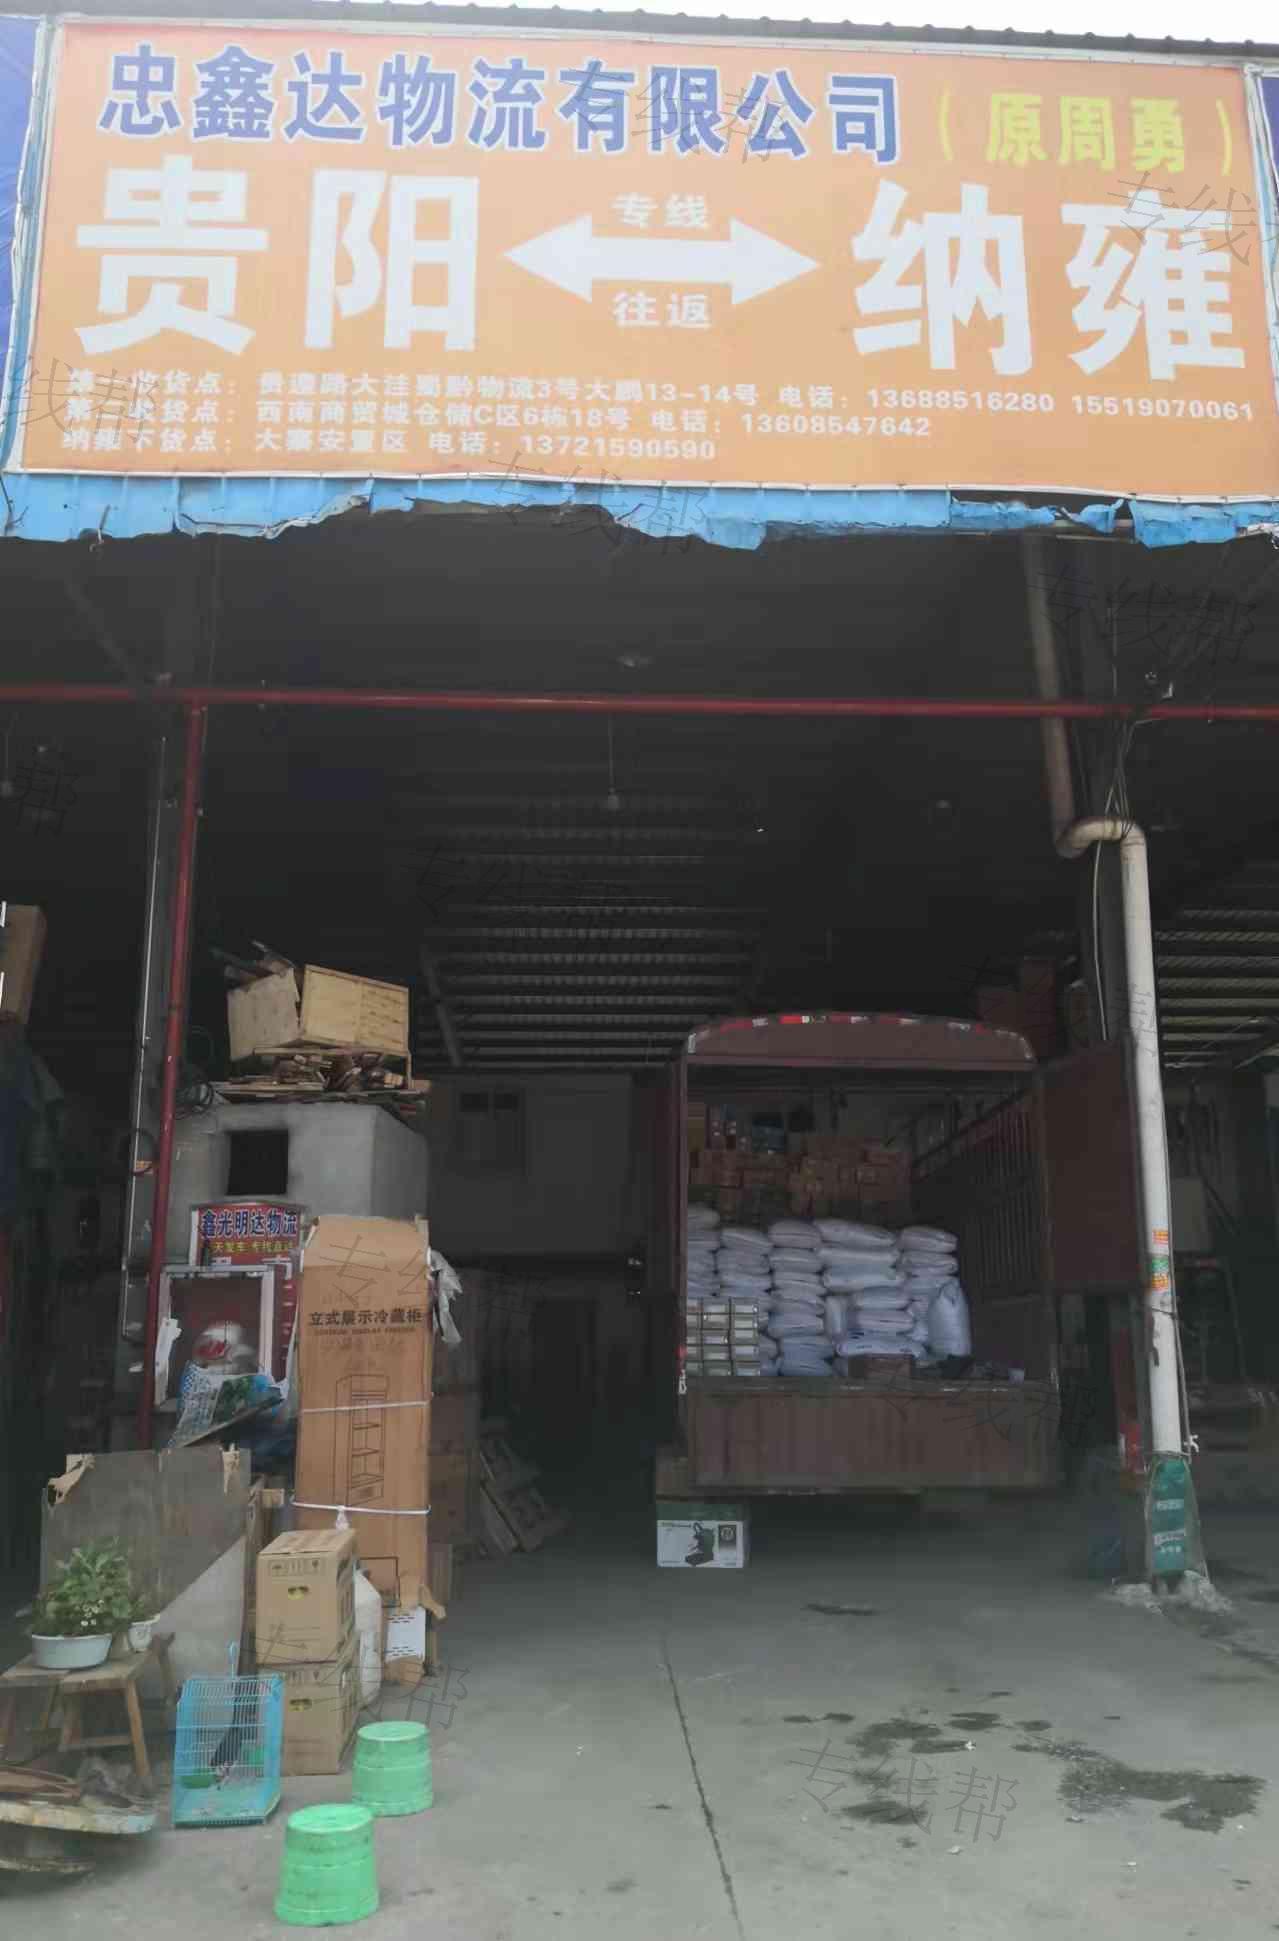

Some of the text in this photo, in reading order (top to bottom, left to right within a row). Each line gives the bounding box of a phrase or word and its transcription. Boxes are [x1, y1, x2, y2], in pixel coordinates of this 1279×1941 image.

[97, 43, 901, 164] 忠鑫达物流有限公司
[611, 193, 711, 231] 专线
[74, 153, 480, 356] 贵阳
[852, 180, 1246, 382] 纳雍
[611, 291, 713, 331] 往返
[1071, 394, 1254, 422] 15519070061
